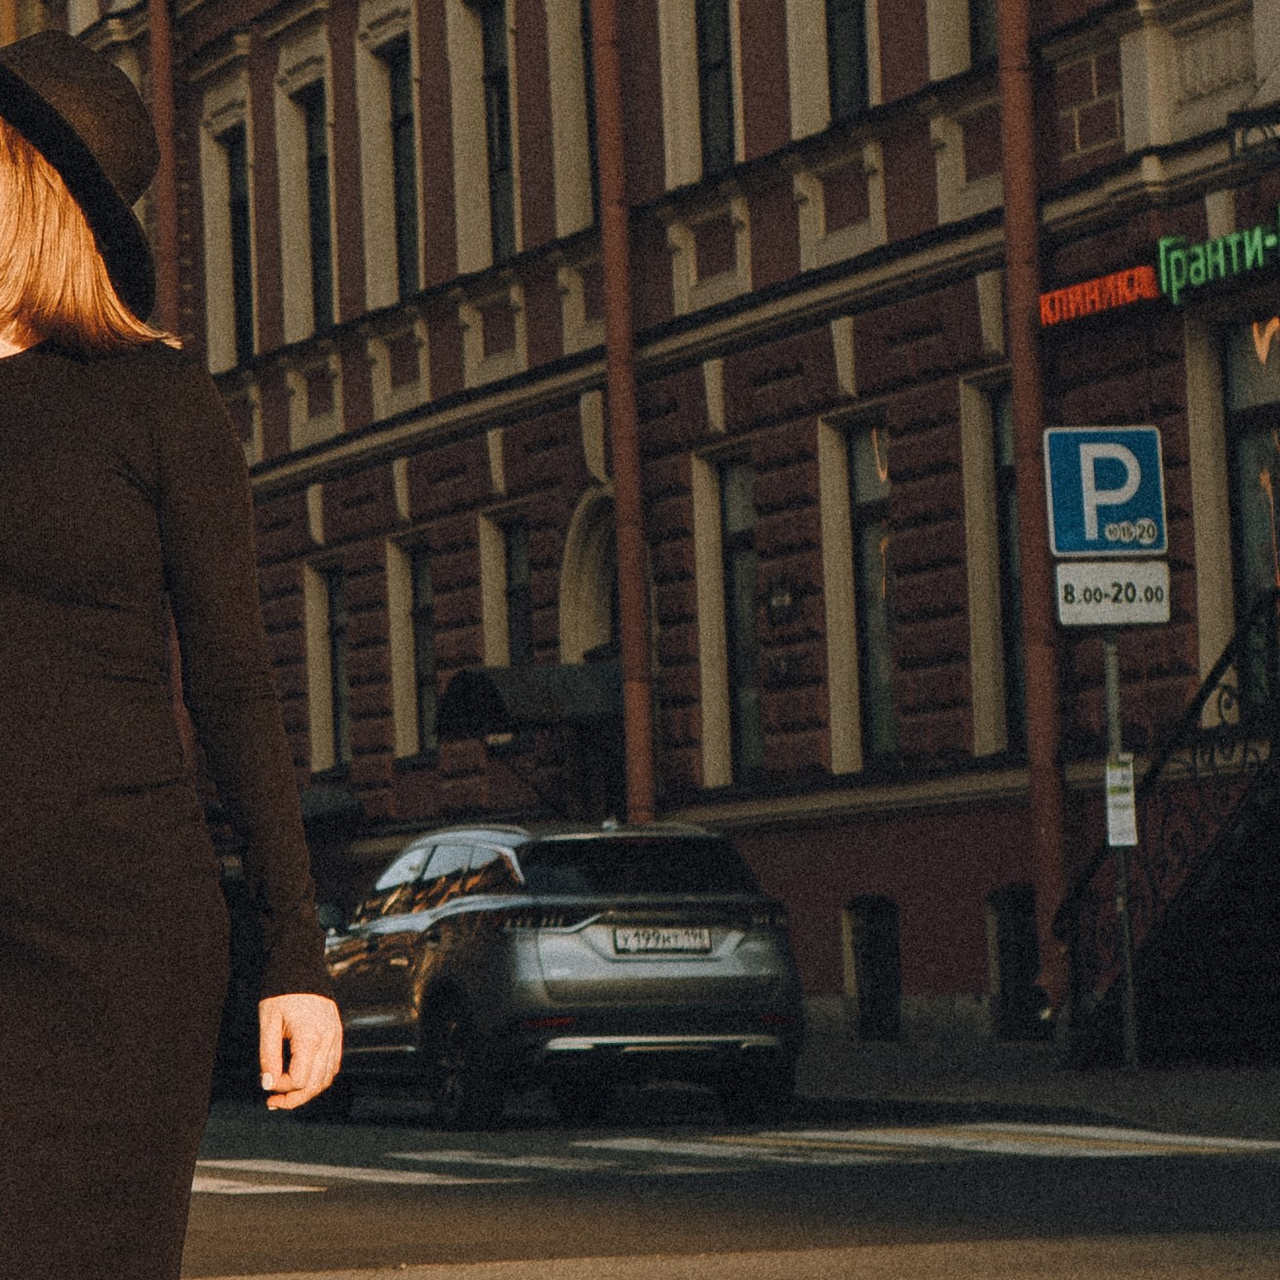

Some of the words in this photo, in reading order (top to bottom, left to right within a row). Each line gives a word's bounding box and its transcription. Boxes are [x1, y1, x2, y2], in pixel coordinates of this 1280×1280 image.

[1159, 210, 1280, 306] Гранти-
[1079, 442, 1142, 541] P
[1137, 523, 1156, 539] 20
[1063, 582, 1165, 604] 8.00-20.00
